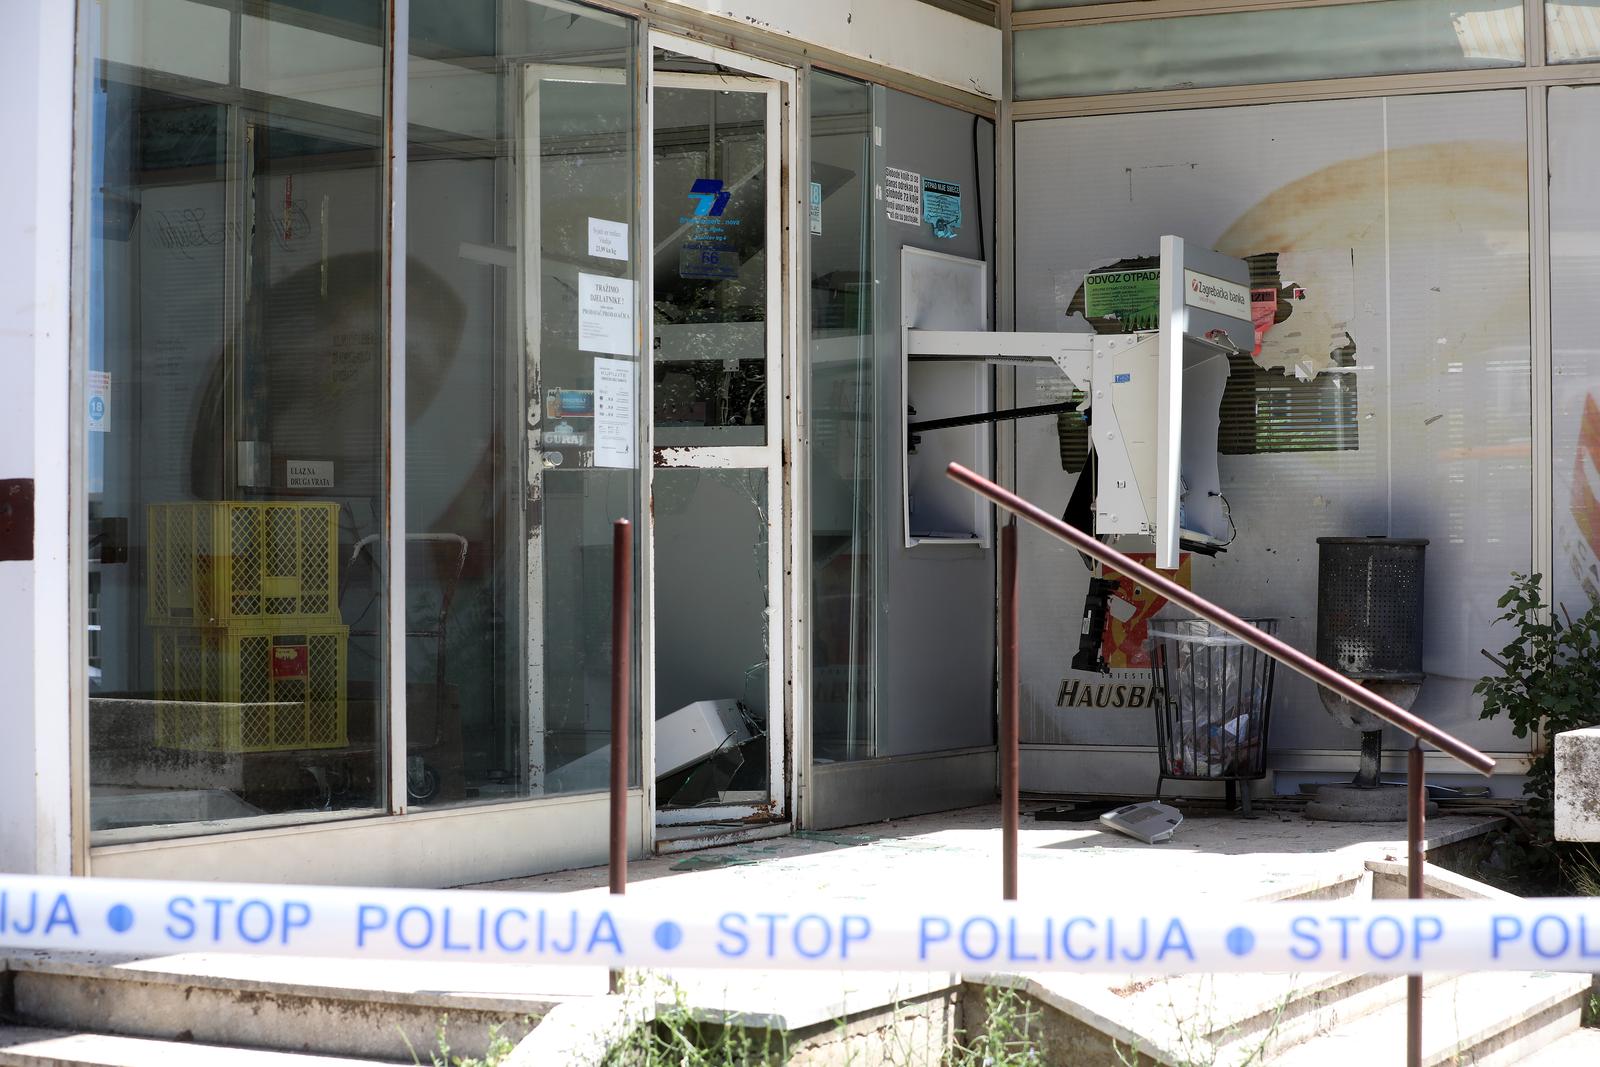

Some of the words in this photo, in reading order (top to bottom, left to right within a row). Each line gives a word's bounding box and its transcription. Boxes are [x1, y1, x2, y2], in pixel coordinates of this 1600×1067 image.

[1087, 274, 1121, 285] ODVOZ
[1199, 281, 1229, 301] Zagrebačka
[1229, 290, 1245, 305] banka
[544, 434, 584, 446] GURAJ
[0, 891, 79, 936] IJA
[165, 896, 312, 944] STOP
[357, 903, 624, 954] POLICIJA
[716, 912, 872, 959] STOP
[918, 915, 1196, 962] POLICIJA
[1289, 915, 1444, 961] STOP
[1490, 915, 1600, 961] POL
